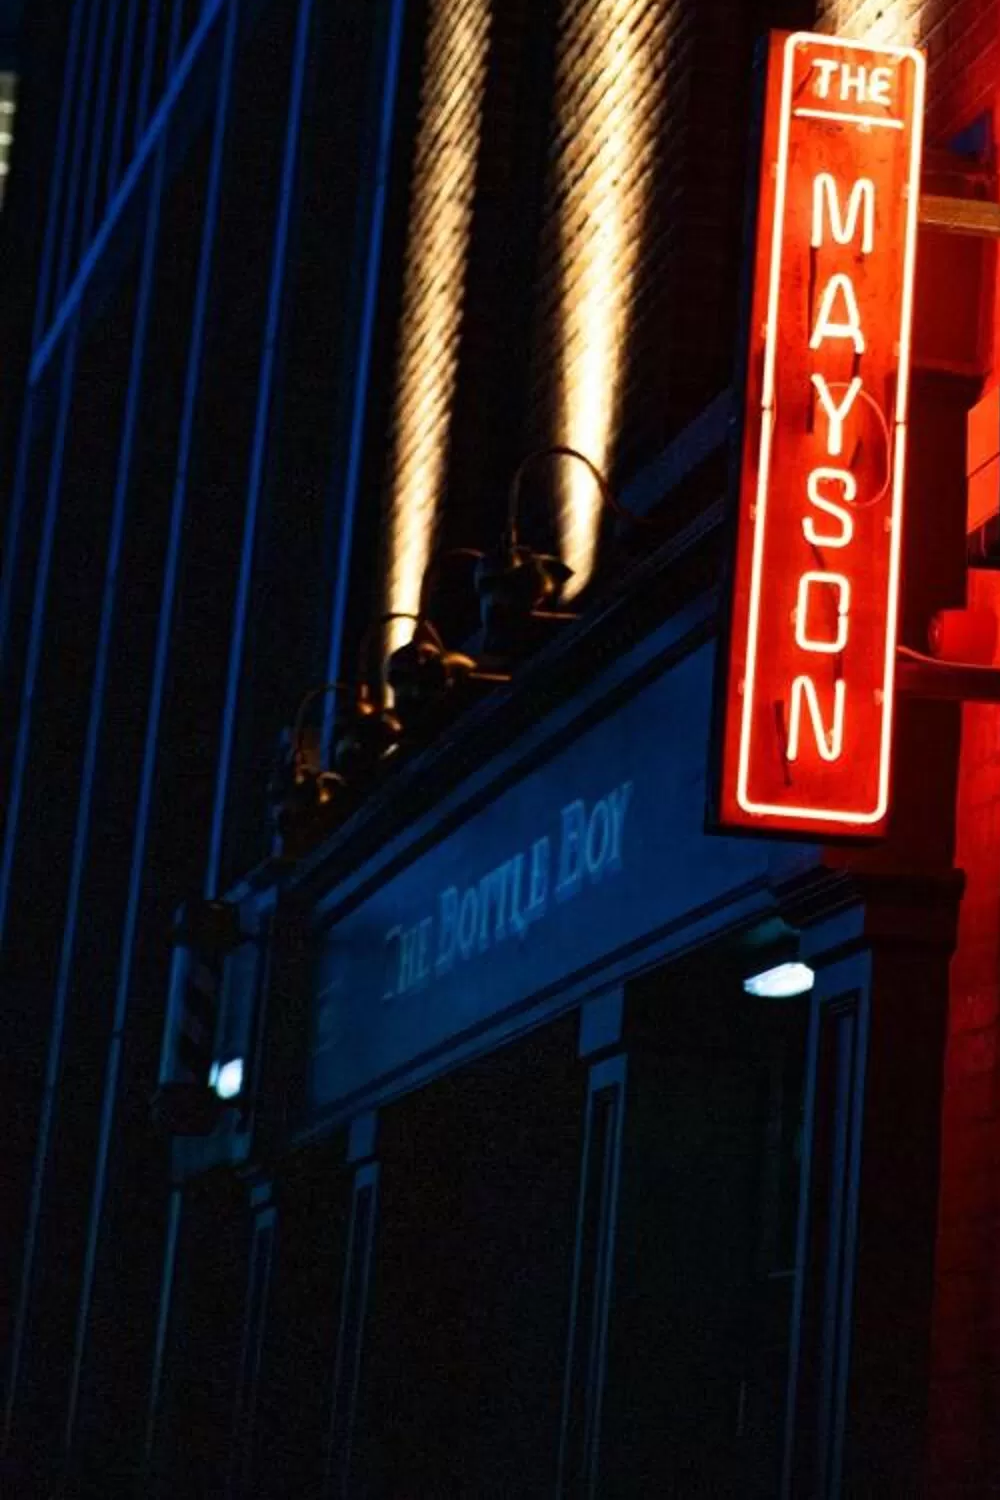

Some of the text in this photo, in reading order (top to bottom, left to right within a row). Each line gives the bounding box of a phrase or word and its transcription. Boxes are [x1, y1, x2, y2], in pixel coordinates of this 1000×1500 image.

[811, 58, 897, 106] THE
[787, 172, 875, 762] MAYSON
[380, 779, 635, 1005] THE BOTTLE BOY
